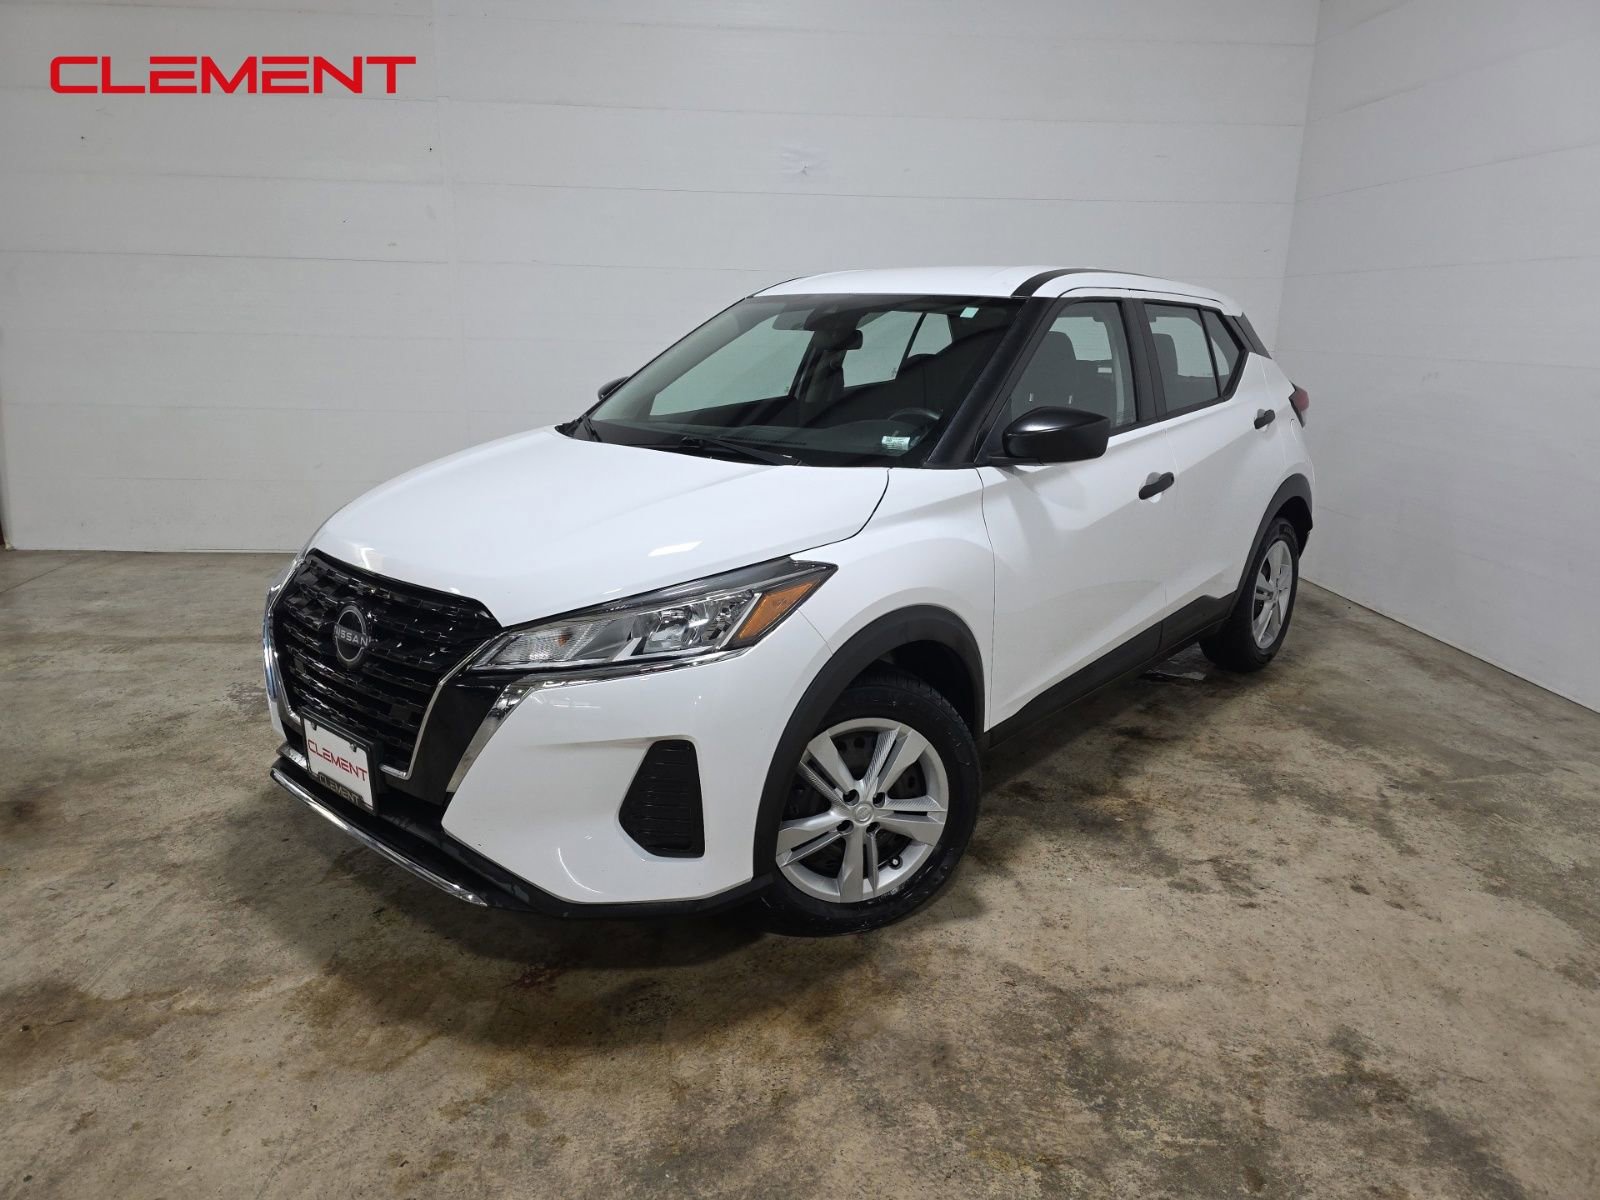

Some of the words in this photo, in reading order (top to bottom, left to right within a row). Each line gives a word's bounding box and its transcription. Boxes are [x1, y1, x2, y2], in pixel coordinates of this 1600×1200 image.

[334, 626, 369, 647] NISSAN
[307, 739, 368, 782] CLEMENT
[319, 774, 361, 803] CLEMENT
